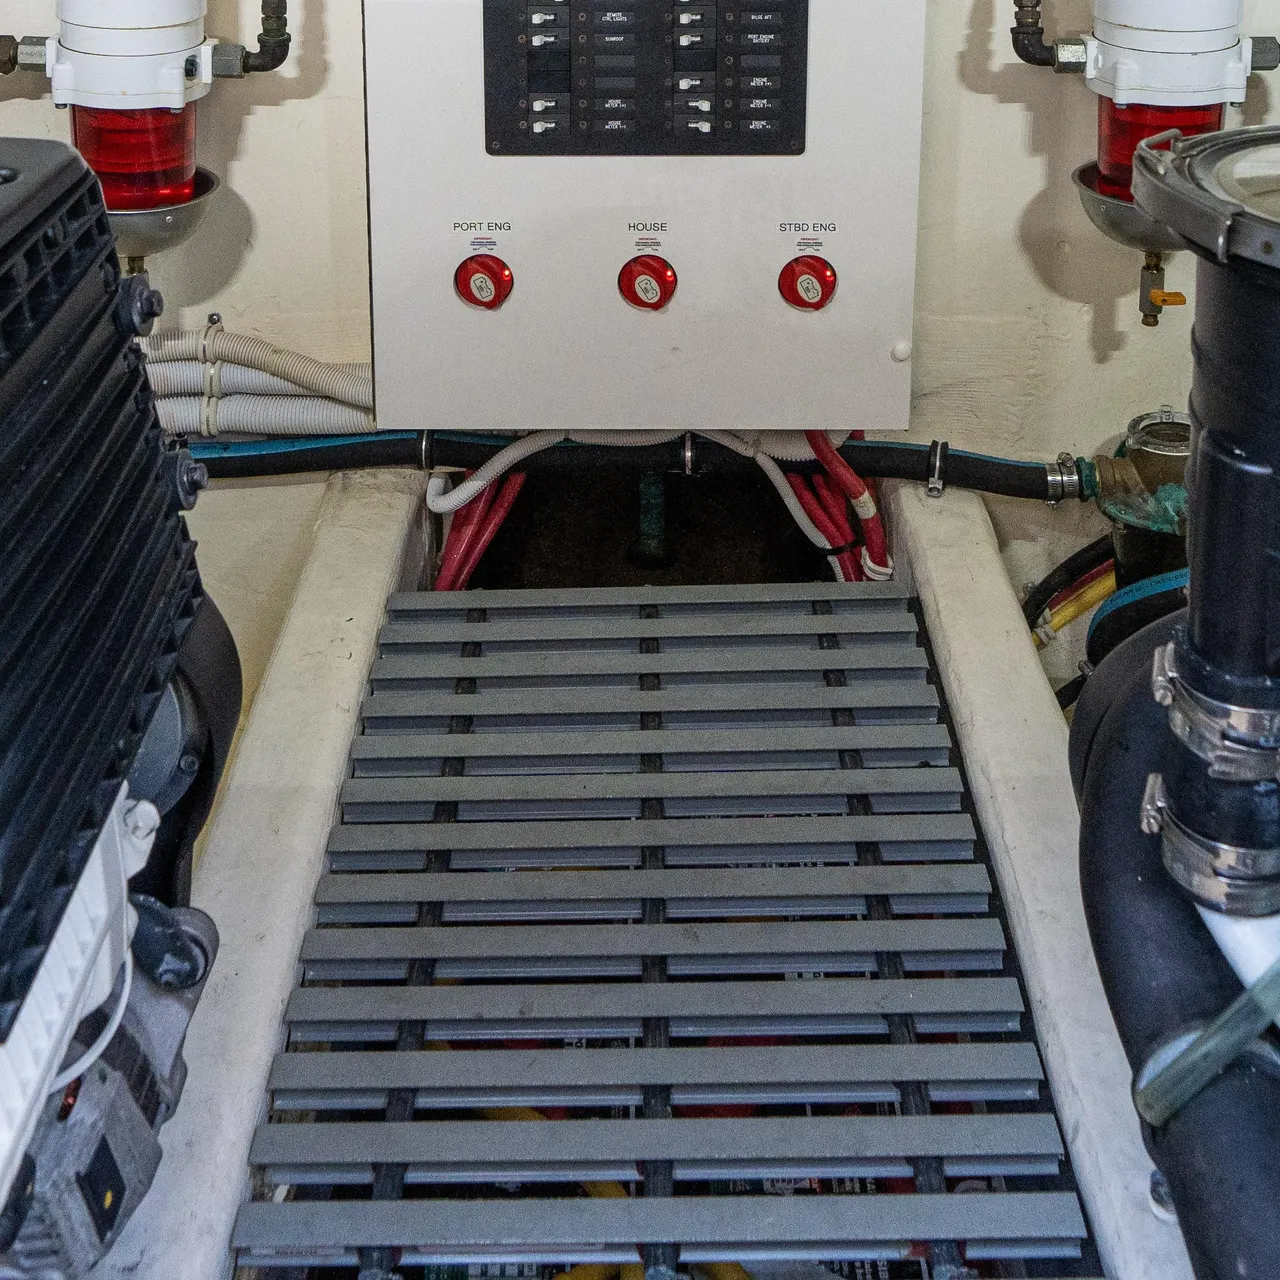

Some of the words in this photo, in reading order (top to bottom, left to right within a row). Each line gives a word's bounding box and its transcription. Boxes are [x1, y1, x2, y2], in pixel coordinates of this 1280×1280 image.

[453, 222, 484, 231] PORT
[488, 222, 511, 231] ENG
[628, 223, 667, 231] HOUSE
[780, 223, 809, 232] STBD
[812, 223, 836, 232] ENG
